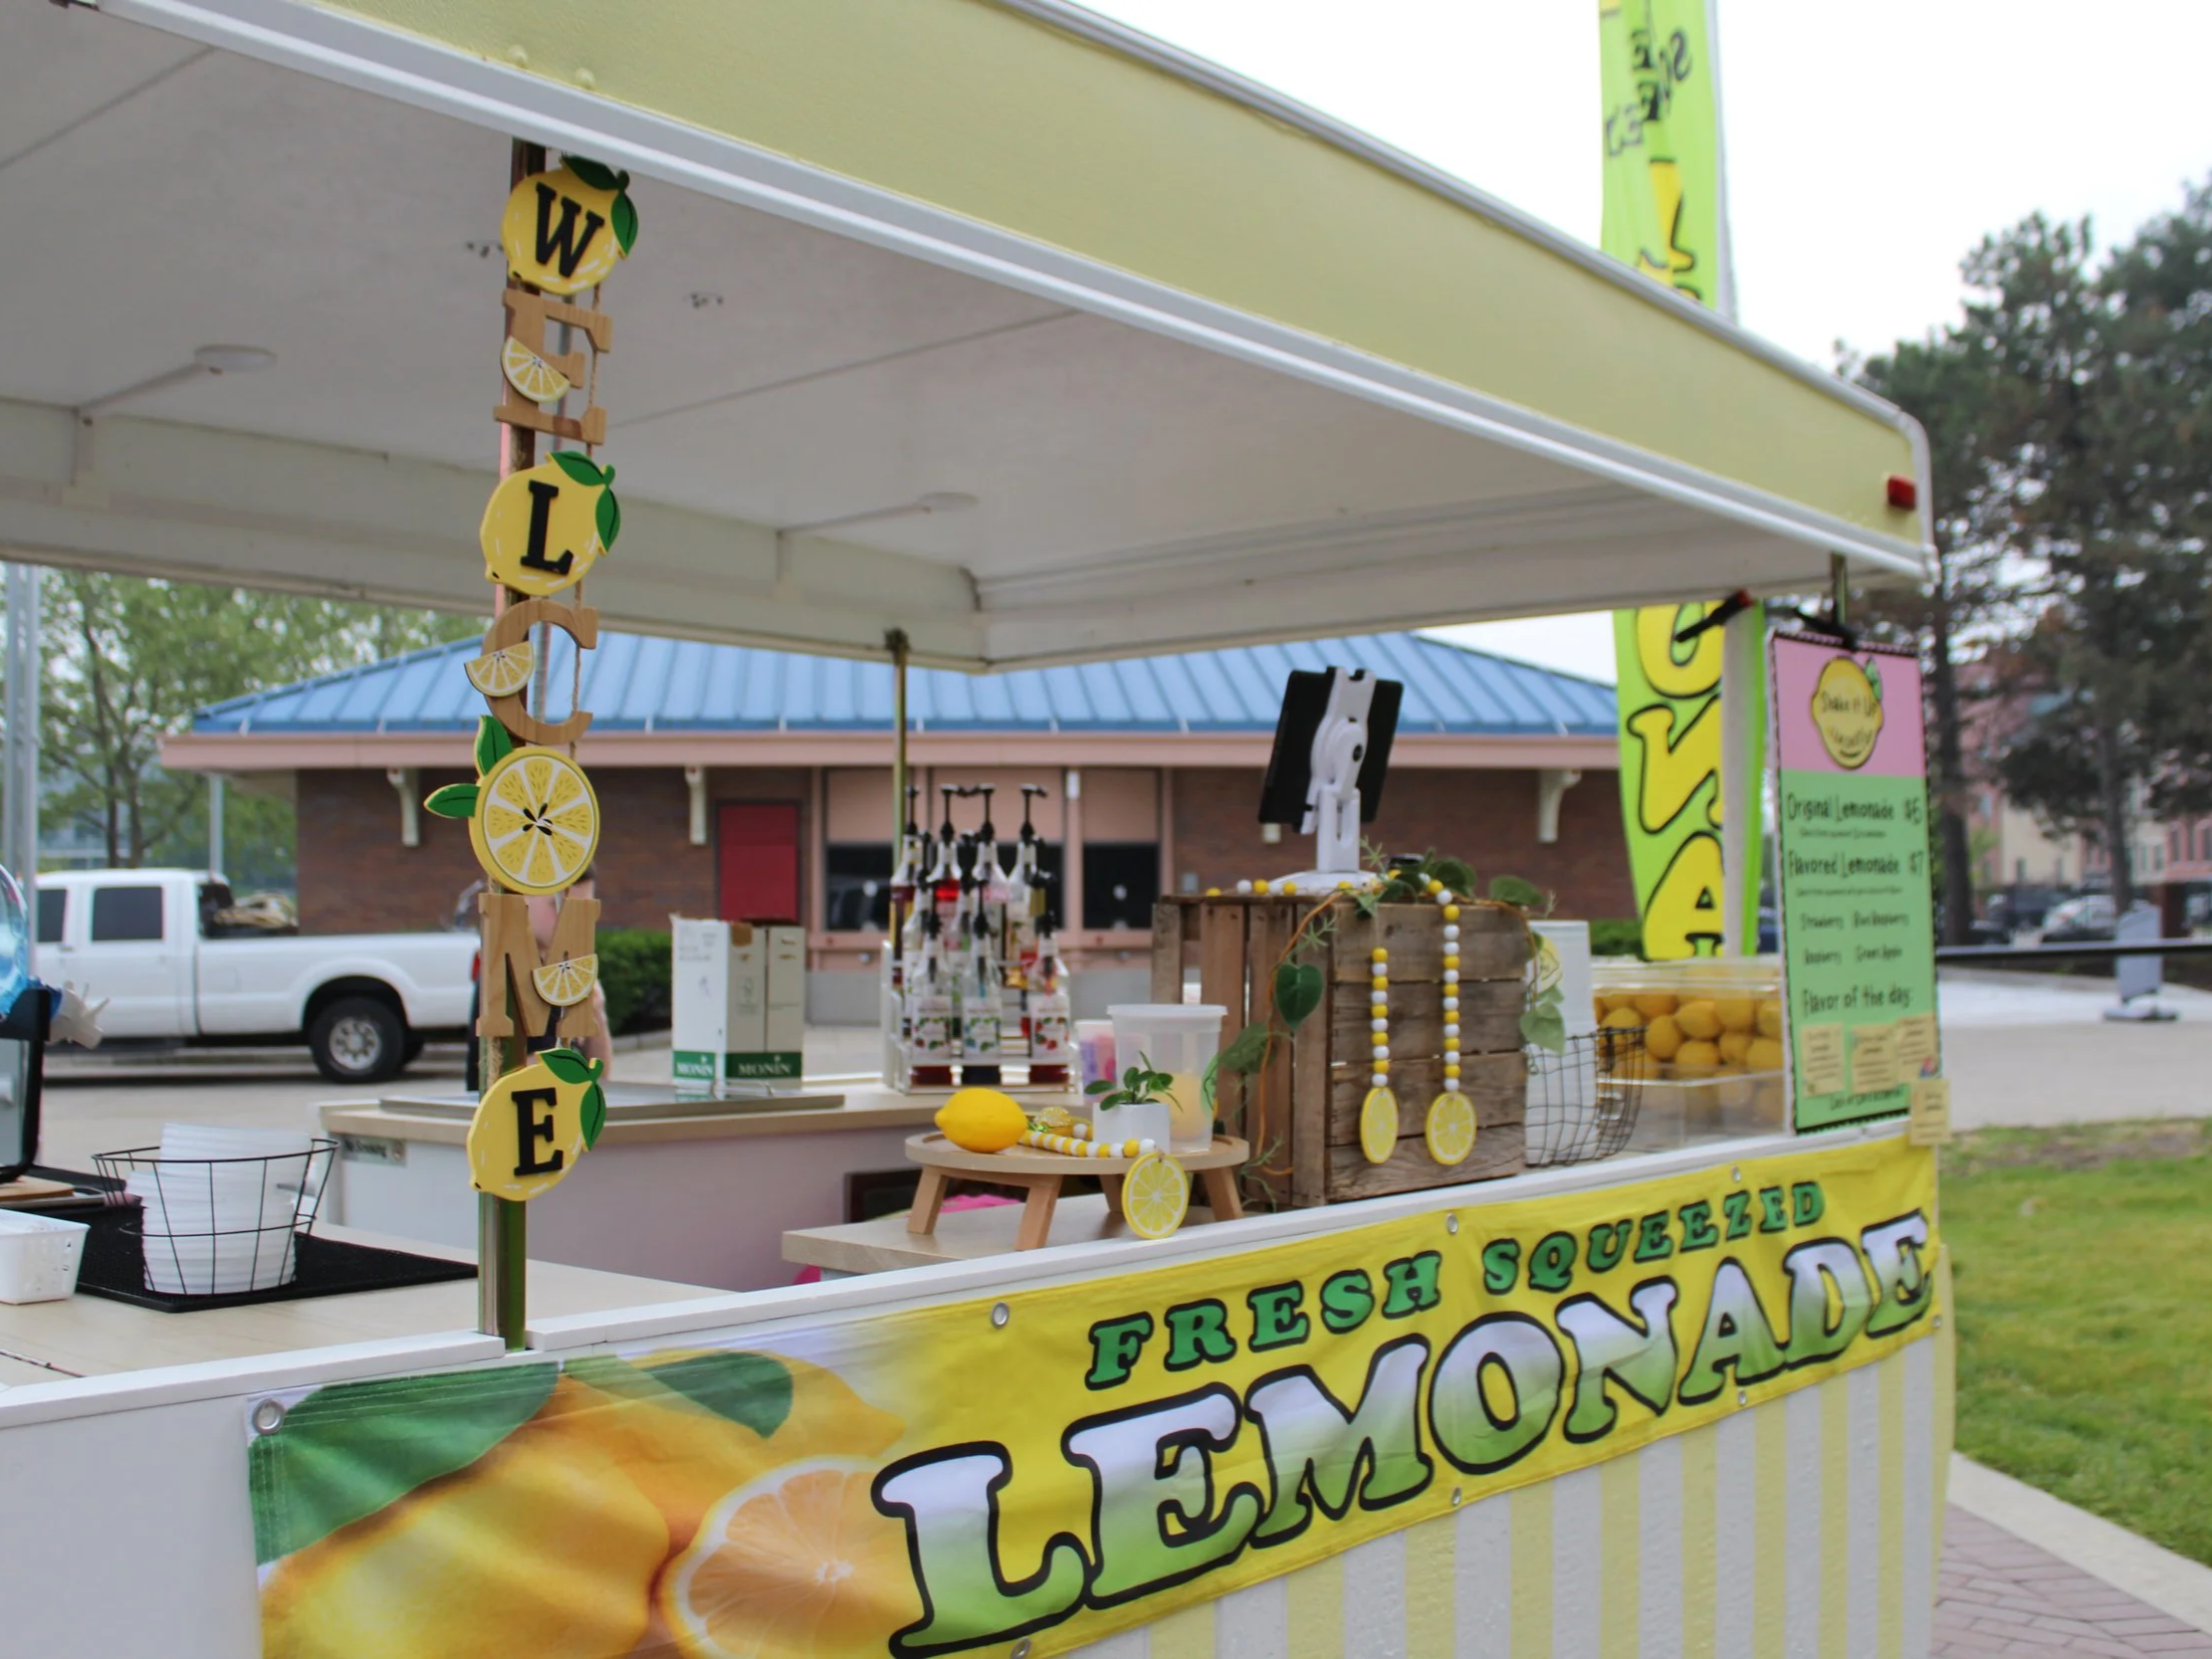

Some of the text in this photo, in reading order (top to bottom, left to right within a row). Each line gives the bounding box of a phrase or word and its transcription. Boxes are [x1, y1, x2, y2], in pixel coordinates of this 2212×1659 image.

[1787, 792, 1832, 821] Original
[1834, 794, 1895, 823] Lemonade
[1788, 850, 1839, 879] Flavored
[1840, 851, 1900, 879] Lemonade
[1802, 988, 1840, 1018] Flavor
[1844, 985, 1859, 1008] of
[1863, 983, 1885, 1007] the
[738, 1061, 792, 1078] MONIN
[1085, 1180, 1826, 1391] FRESH SQUEEZED
[870, 1209, 1935, 1659] LEMONADE
